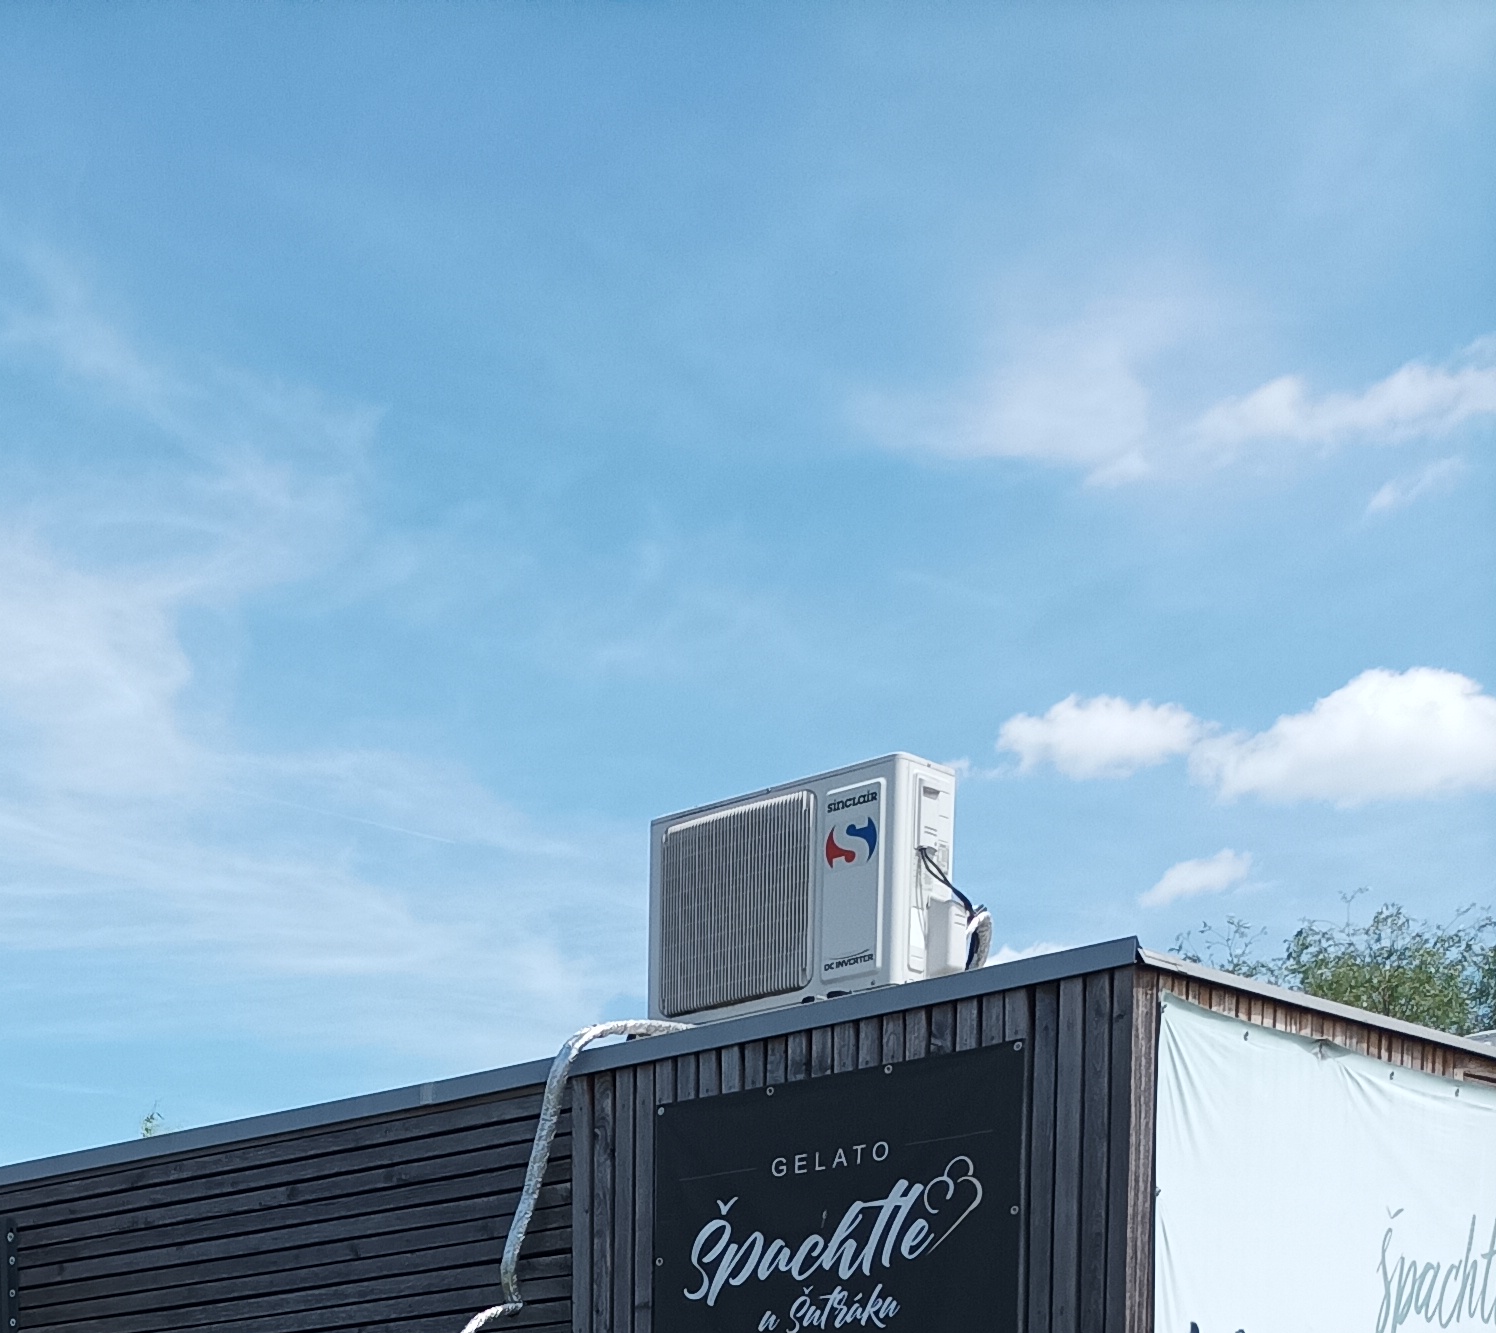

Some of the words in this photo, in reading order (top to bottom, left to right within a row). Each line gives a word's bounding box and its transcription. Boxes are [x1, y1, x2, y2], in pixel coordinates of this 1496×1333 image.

[824, 962, 835, 972] DC
[835, 954, 874, 969] INVERTER
[771, 1141, 890, 1177] GELATO
[684, 1178, 935, 1306] Špachtle
[757, 1310, 780, 1332] u
